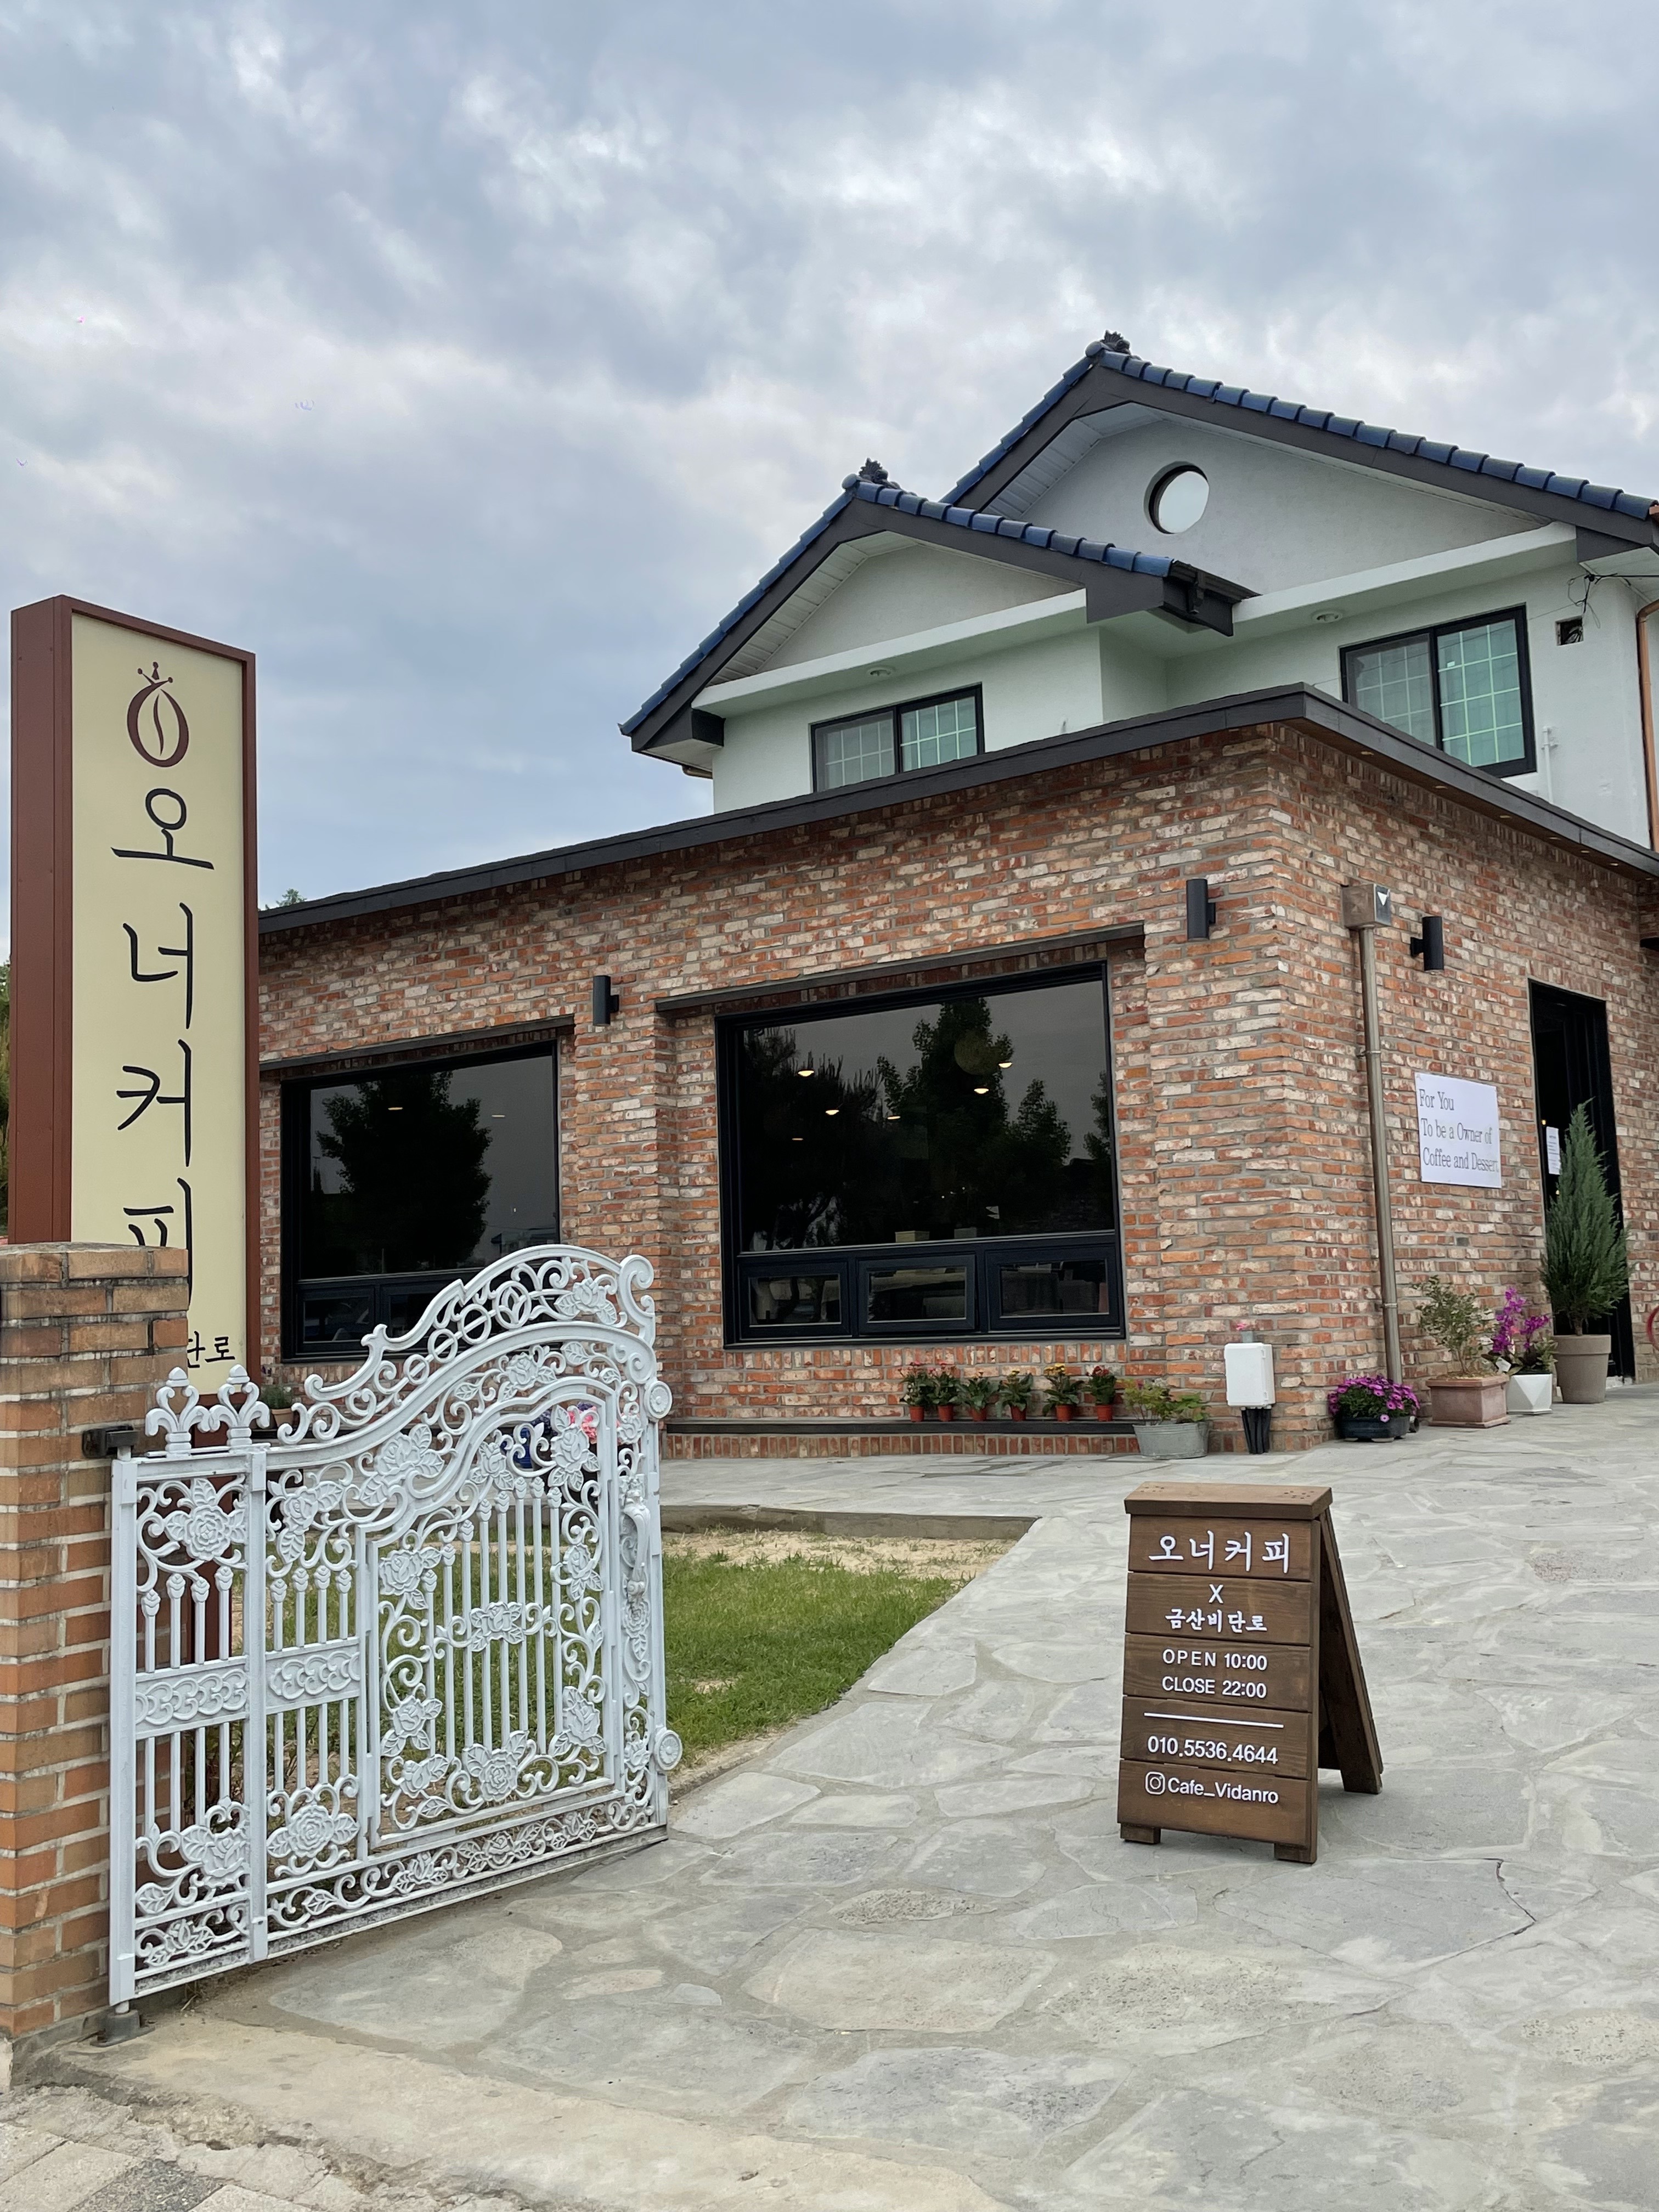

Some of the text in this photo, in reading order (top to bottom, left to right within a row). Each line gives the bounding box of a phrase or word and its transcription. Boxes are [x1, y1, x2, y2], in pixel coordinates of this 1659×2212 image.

[111, 788, 215, 1306] 오너커피
[1419, 1088, 1454, 1110] For You
[1420, 1118, 1493, 1144] To be a Owner of
[1423, 1147, 1499, 1172] Coffee and Dessert
[1148, 1530, 1289, 1573] 오너커피
[1209, 1584, 1224, 1604] X
[1165, 1608, 1267, 1633] 금산비단로
[1163, 1649, 1268, 1671] OPEN 10:00
[1162, 1676, 1267, 1699] CLOSE 22:00
[1148, 1736, 1278, 1764] 010.5536.4644
[1167, 1777, 1279, 1804] Cafe_Vidanro
